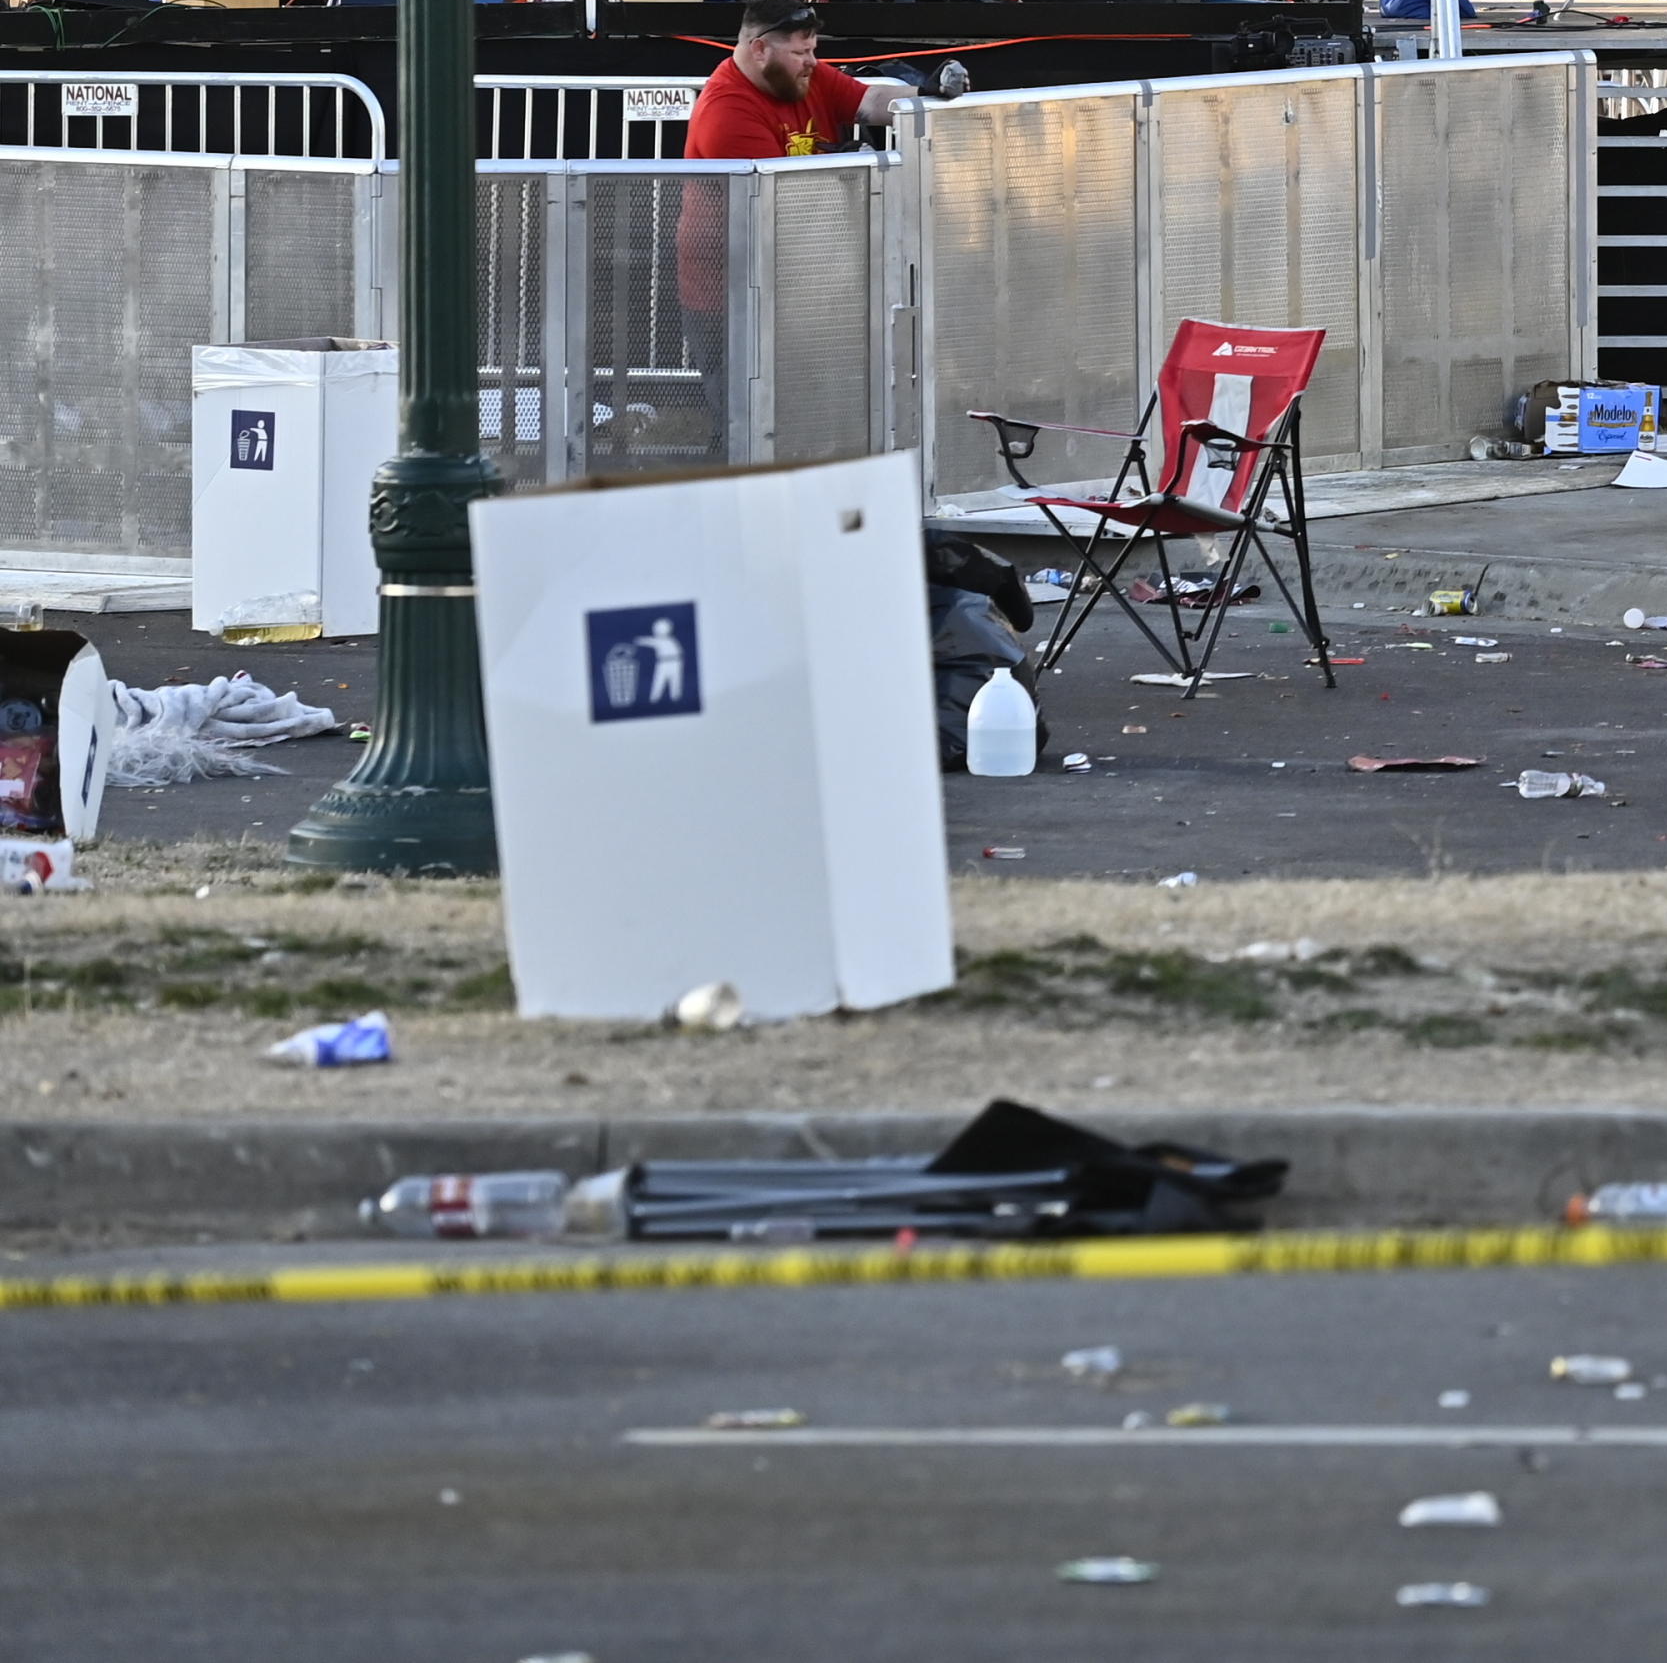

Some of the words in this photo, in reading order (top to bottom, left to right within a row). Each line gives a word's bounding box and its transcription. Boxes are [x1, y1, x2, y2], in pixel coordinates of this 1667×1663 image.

[66, 86, 132, 101] NATIONAL
[627, 90, 690, 105] NATIONAL
[1594, 403, 1632, 421] Modelo
